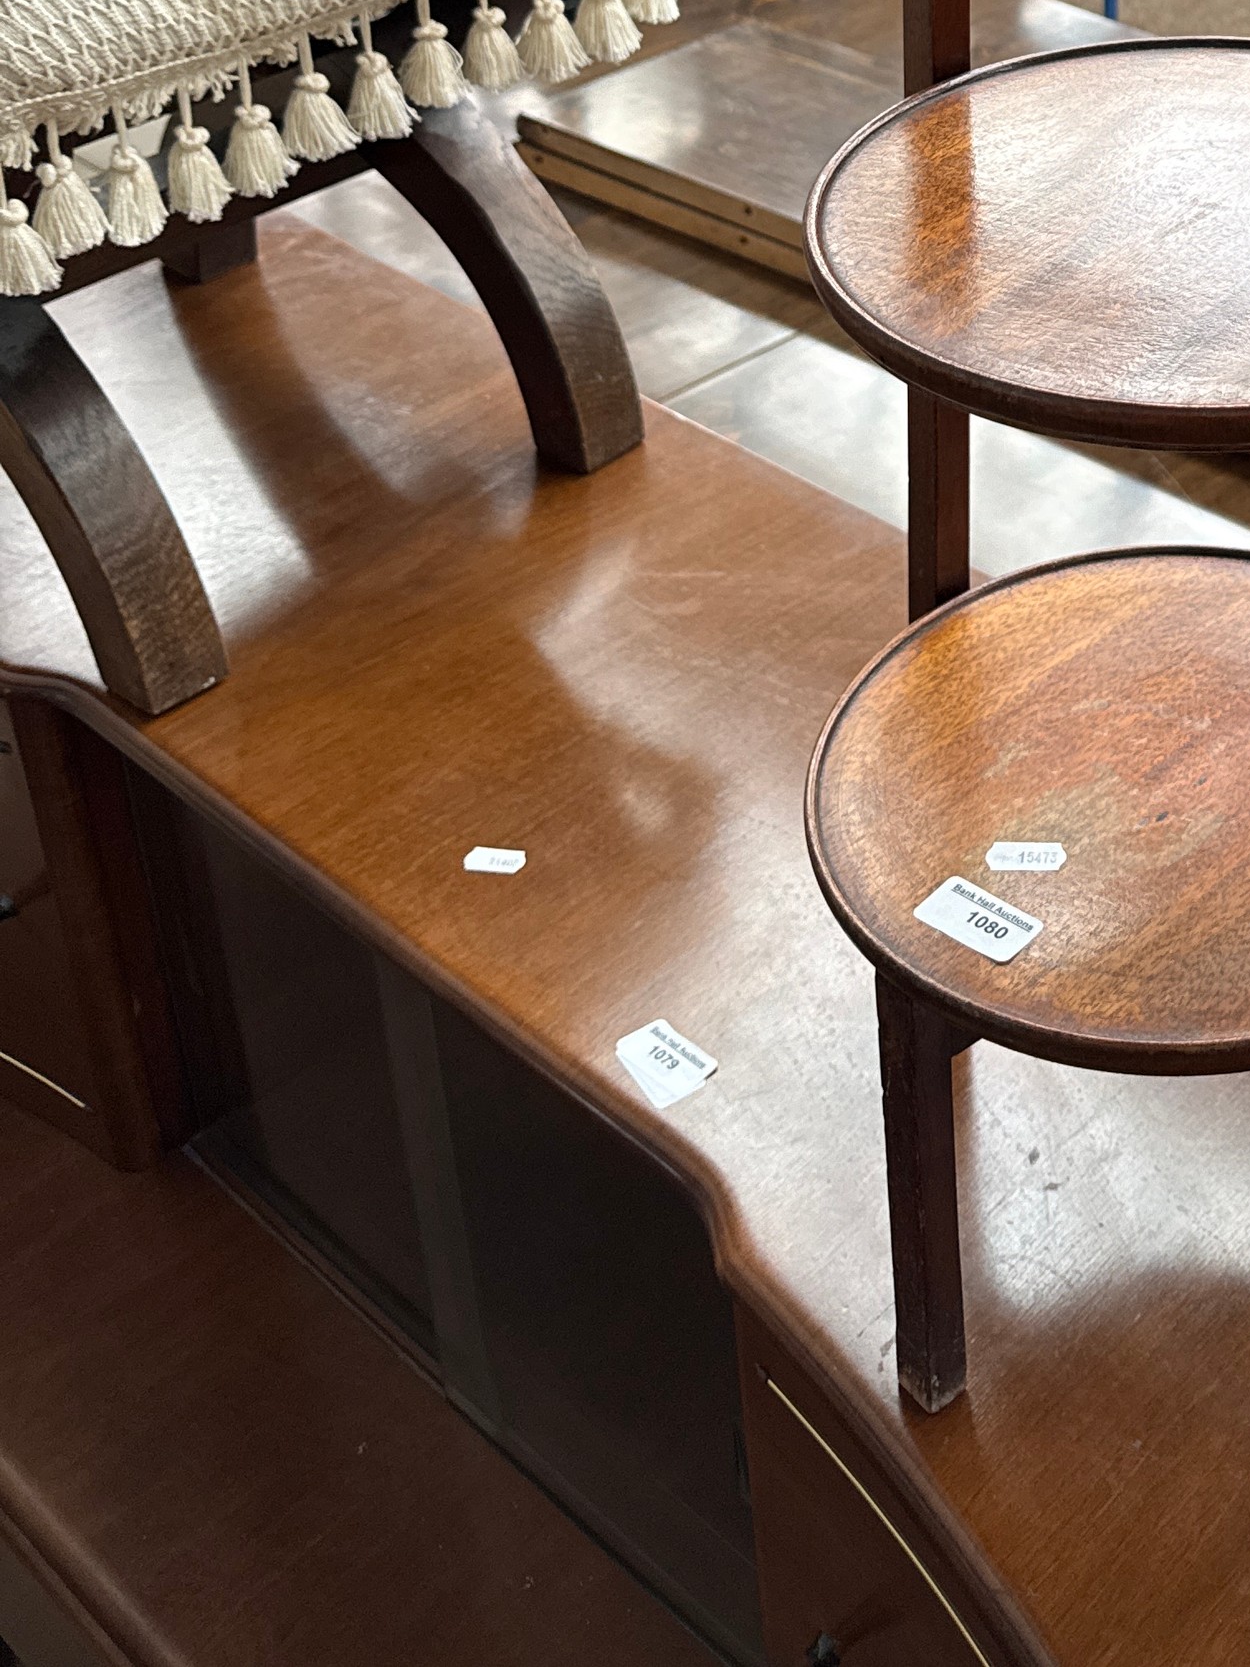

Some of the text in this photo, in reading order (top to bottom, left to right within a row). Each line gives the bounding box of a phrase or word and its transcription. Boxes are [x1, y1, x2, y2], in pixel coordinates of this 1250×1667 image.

[1018, 851, 1058, 863] 15473
[953, 883, 1034, 932] Bank Hall Auctions
[966, 911, 1009, 939] 1080
[649, 1045, 680, 1070] 1079
